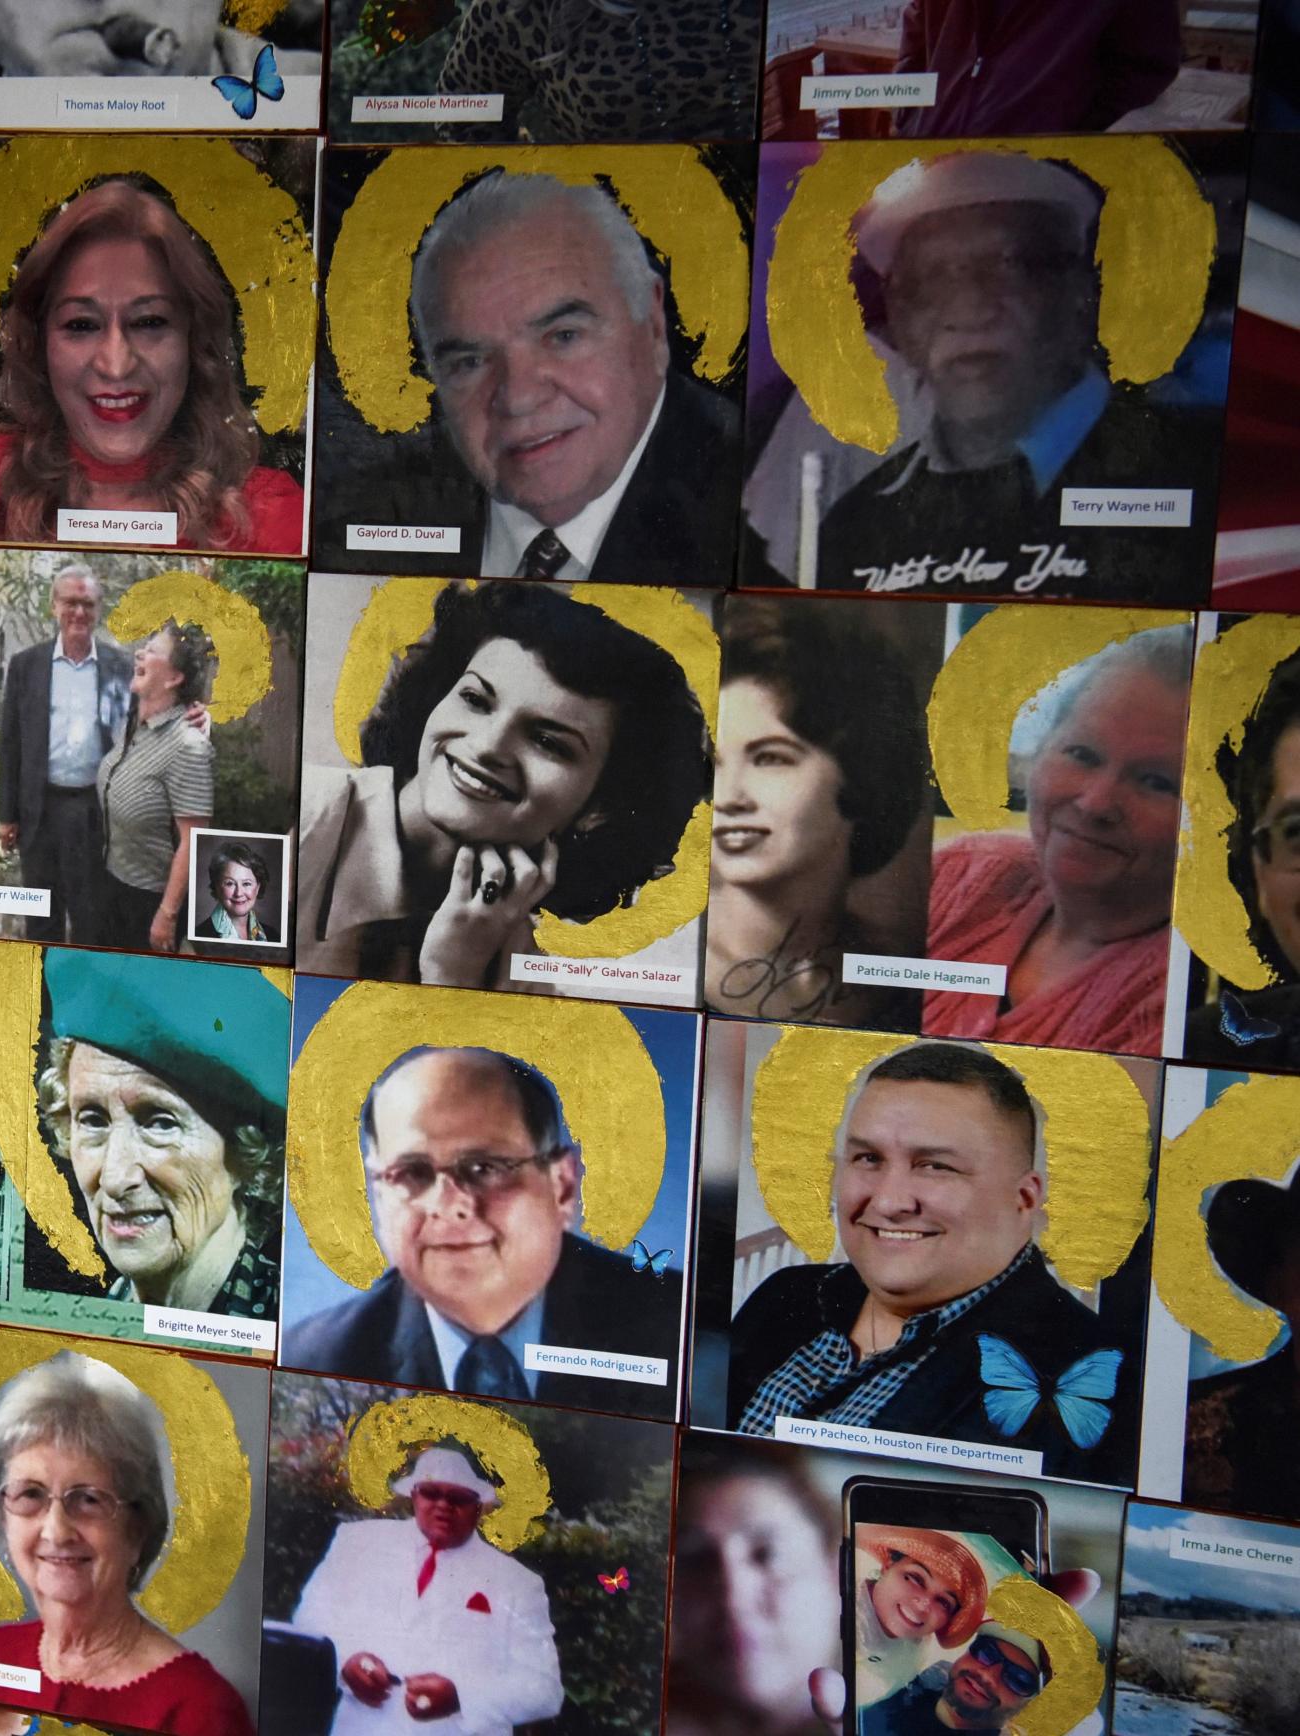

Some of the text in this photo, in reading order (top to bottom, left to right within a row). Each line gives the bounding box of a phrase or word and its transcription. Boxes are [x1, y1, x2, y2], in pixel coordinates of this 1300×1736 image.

[812, 84, 920, 100] Jimmy Don White
[64, 100, 165, 112] Thomas Maloy Root
[365, 97, 488, 111] Alyssa Nicole Martinez
[1071, 500, 1176, 513] Terry Wayne Hill
[67, 518, 163, 532] Teresa Mary Garcia
[357, 527, 445, 540] Gaylord D. Duval
[10, 890, 44, 902] Walker
[524, 960, 559, 972] Cecilia
[601, 967, 639, 980] Galvan
[642, 970, 682, 982] Salazar
[857, 965, 991, 986] Patricia Dale Hagaman
[158, 1318, 262, 1342] Brigitte Meyer Steele
[536, 1352, 660, 1376] Fernando Rodriguez Sr.
[789, 1423, 1024, 1464] Jerry Pacheco, Houston Fire Department
[1181, 1538, 1294, 1565] Irma Jane Cherne
